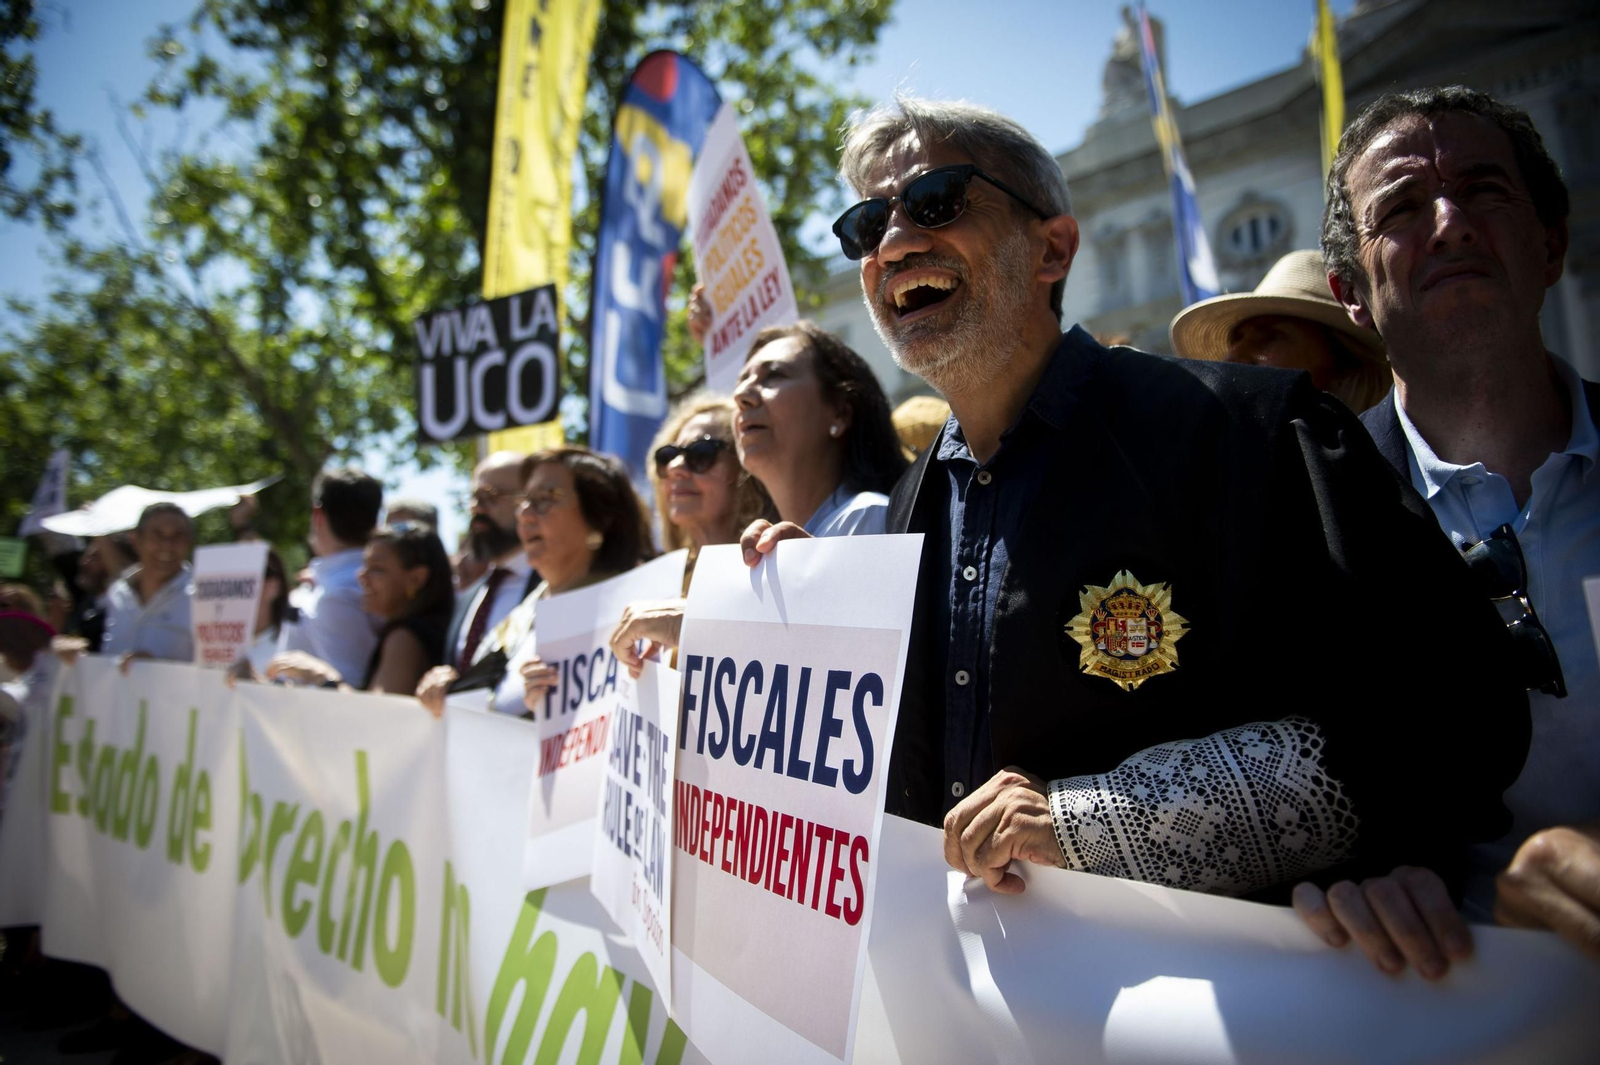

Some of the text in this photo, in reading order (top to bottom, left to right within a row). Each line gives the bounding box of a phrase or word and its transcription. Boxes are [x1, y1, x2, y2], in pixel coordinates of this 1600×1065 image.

[415, 288, 558, 358] VIVA LA
[711, 265, 782, 358] ANTE LA LEY
[421, 342, 558, 440] UCO
[544, 647, 619, 720] FISCA
[1100, 662, 1160, 678] MAGISTRADO
[647, 720, 669, 820] THE
[679, 654, 884, 795] FISCALES
[51, 695, 158, 850] Estado
[166, 708, 213, 874] de
[674, 778, 869, 927] INDEPENDIENTES
